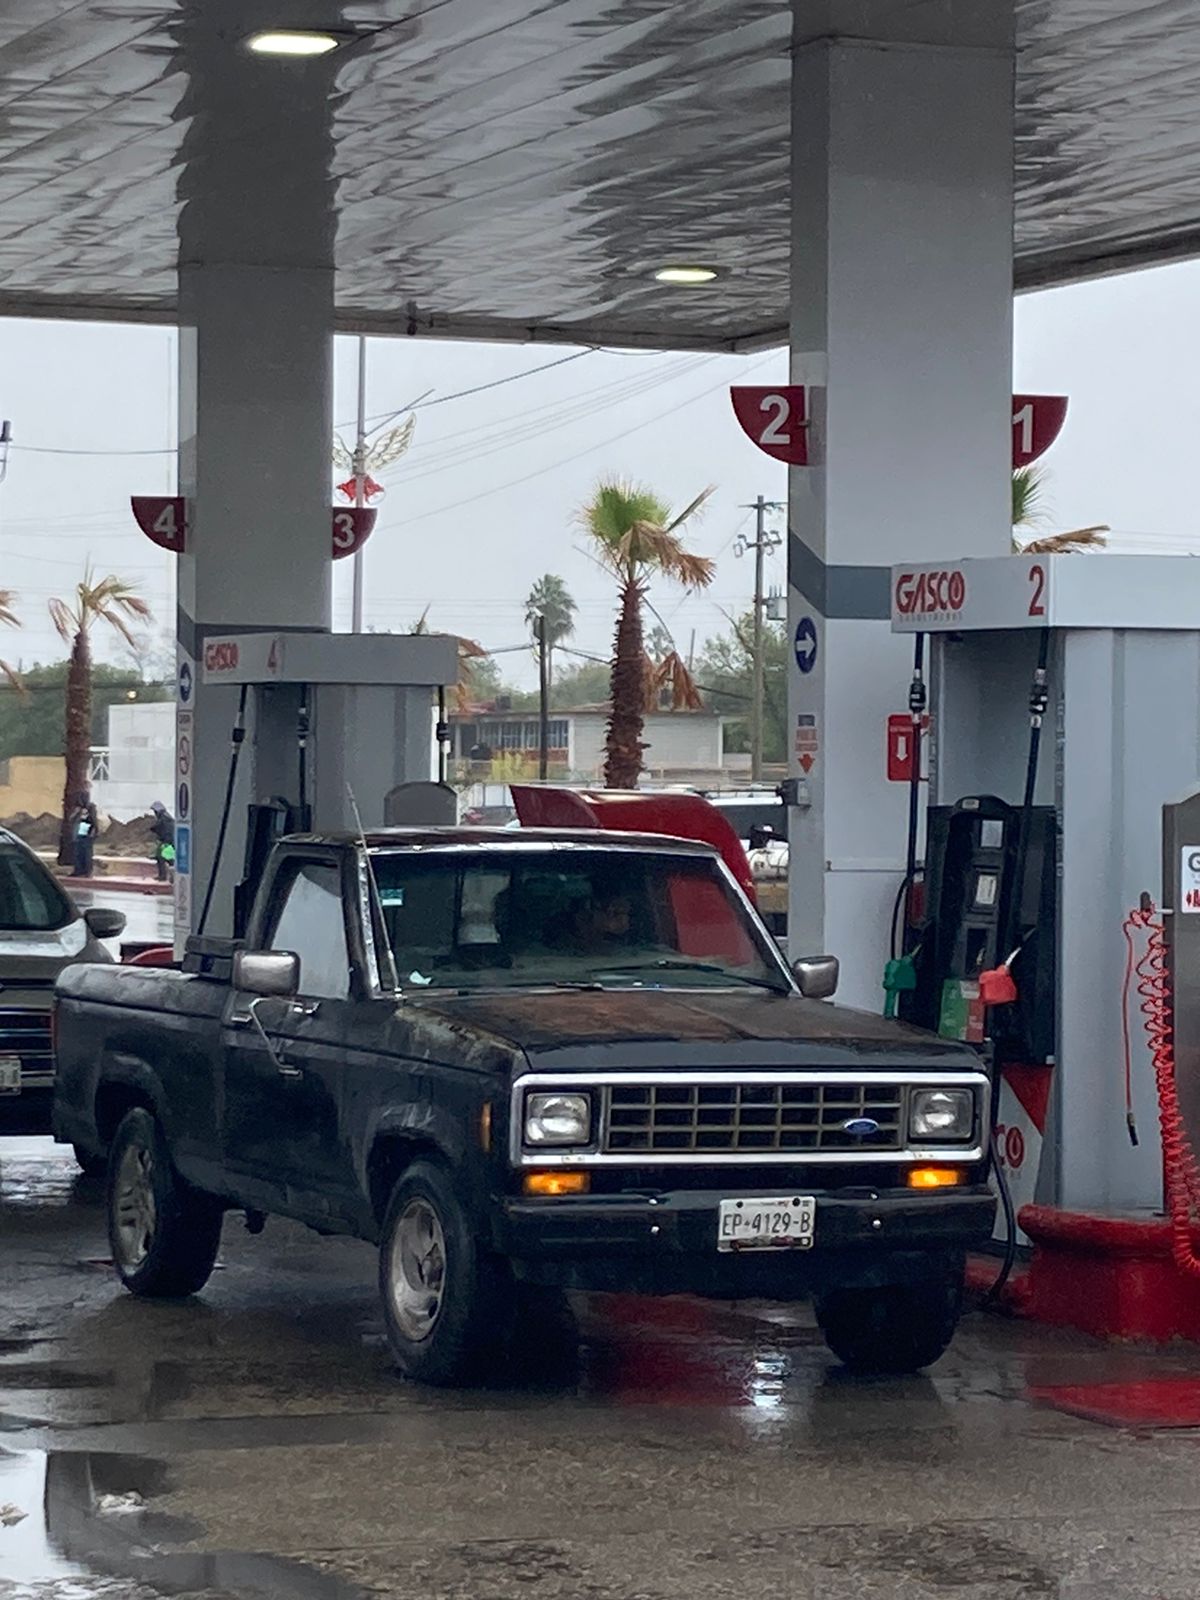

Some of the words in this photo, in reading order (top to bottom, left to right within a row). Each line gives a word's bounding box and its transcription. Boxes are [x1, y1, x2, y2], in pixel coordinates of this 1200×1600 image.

[759, 394, 791, 445] 2
[1012, 403, 1034, 453] 1
[153, 503, 178, 539] 4
[333, 513, 355, 548] 3
[896, 570, 965, 614] GASCO
[1028, 564, 1045, 617] 2
[267, 638, 277, 675] 4
